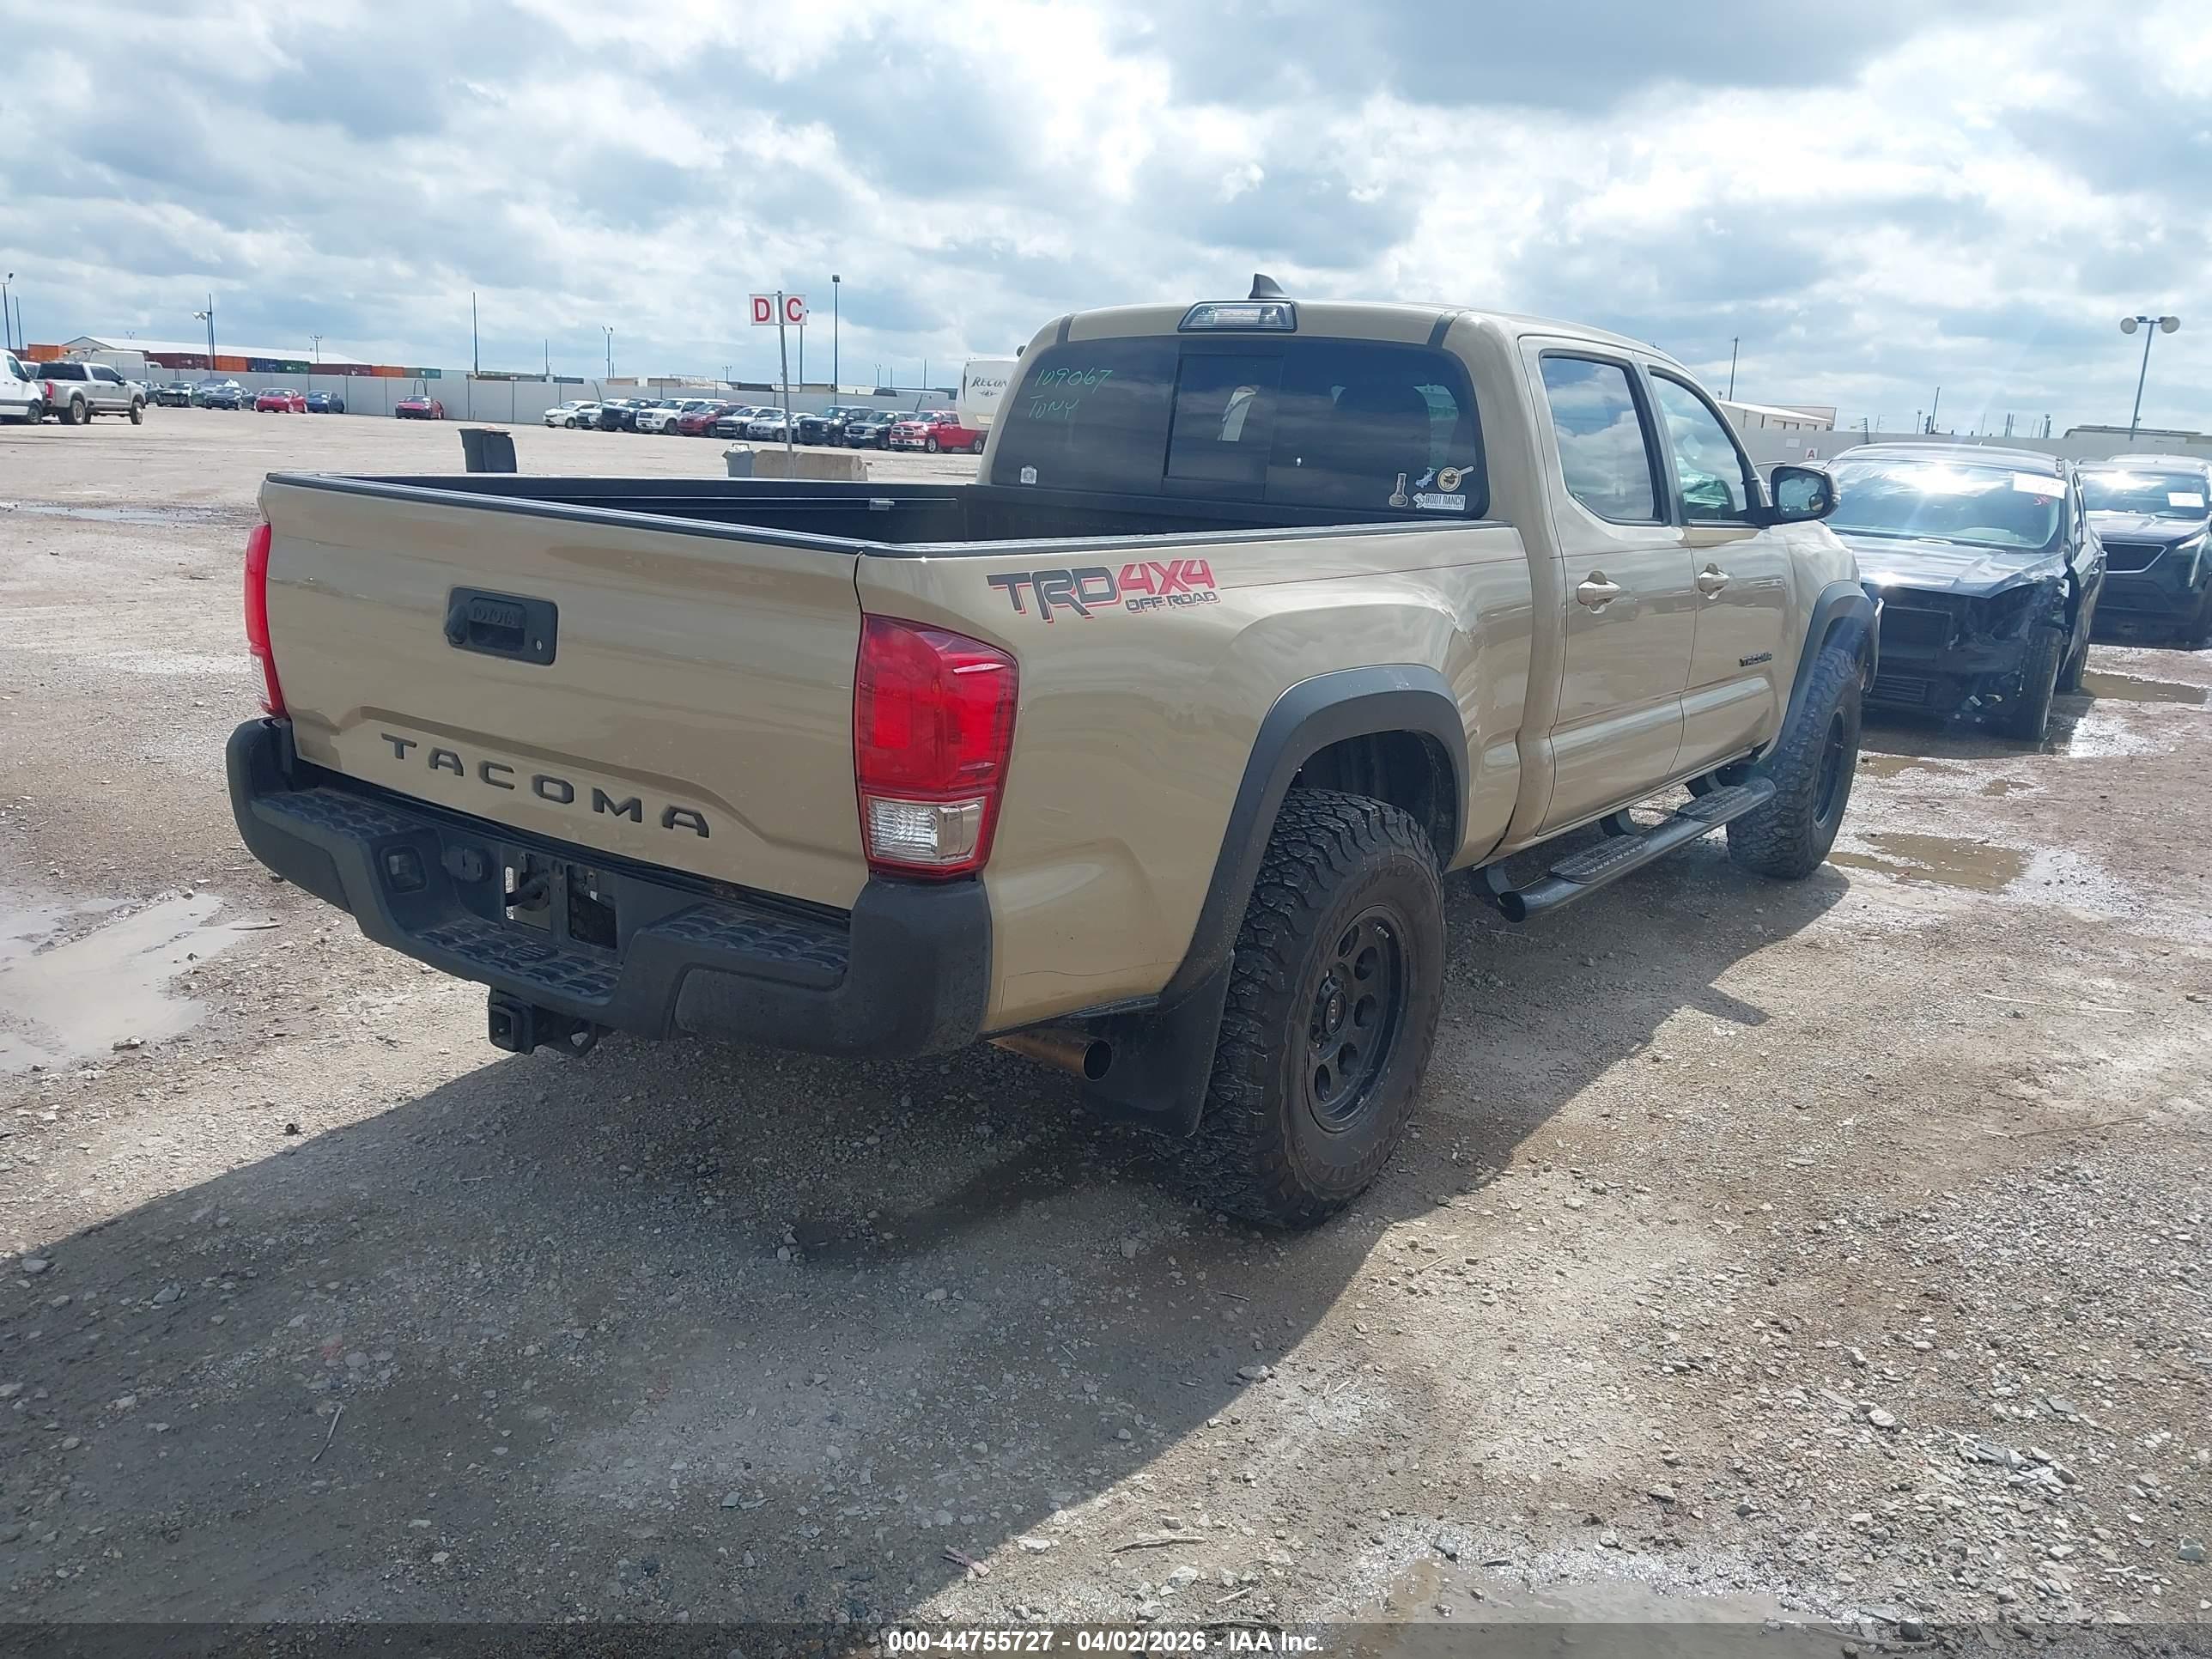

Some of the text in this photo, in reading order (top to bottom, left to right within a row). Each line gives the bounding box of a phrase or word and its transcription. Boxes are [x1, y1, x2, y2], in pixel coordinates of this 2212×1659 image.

[754, 298, 770, 322] D
[787, 297, 803, 322] C
[1034, 367, 1114, 394] 109067
[1807, 448, 1815, 459] A
[1126, 591, 1221, 614] OFF ROAD
[380, 732, 710, 839] TACOMA
